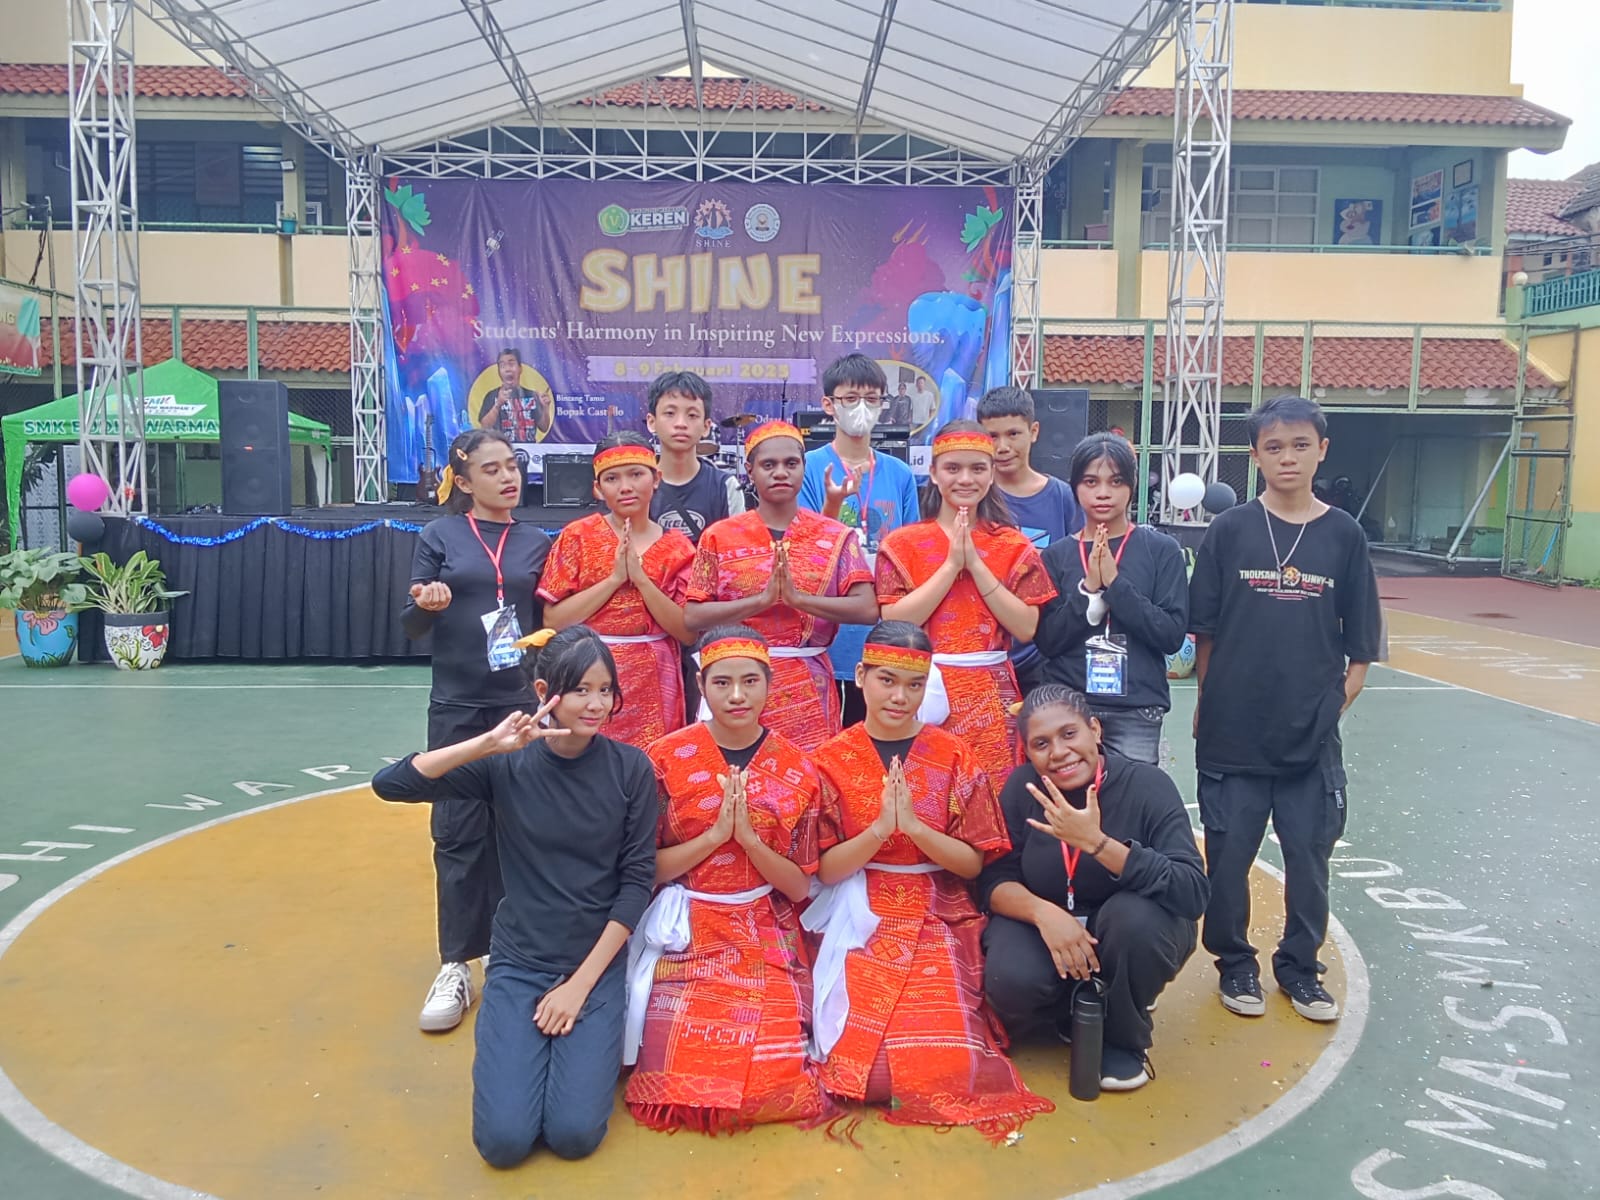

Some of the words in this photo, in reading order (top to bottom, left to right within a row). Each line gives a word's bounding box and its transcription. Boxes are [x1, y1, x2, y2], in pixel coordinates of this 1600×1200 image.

[630, 211, 686, 226] KEREN
[695, 240, 732, 248] SHINE
[579, 248, 821, 315] SHINE
[473, 320, 561, 340] Students'
[566, 321, 658, 347] Harmony
[664, 323, 682, 340] in
[689, 322, 775, 349] Inspiring
[781, 324, 824, 342] New
[831, 325, 945, 349] Expressions.
[556, 405, 585, 419] Bopak
[24, 419, 67, 434] SMK
